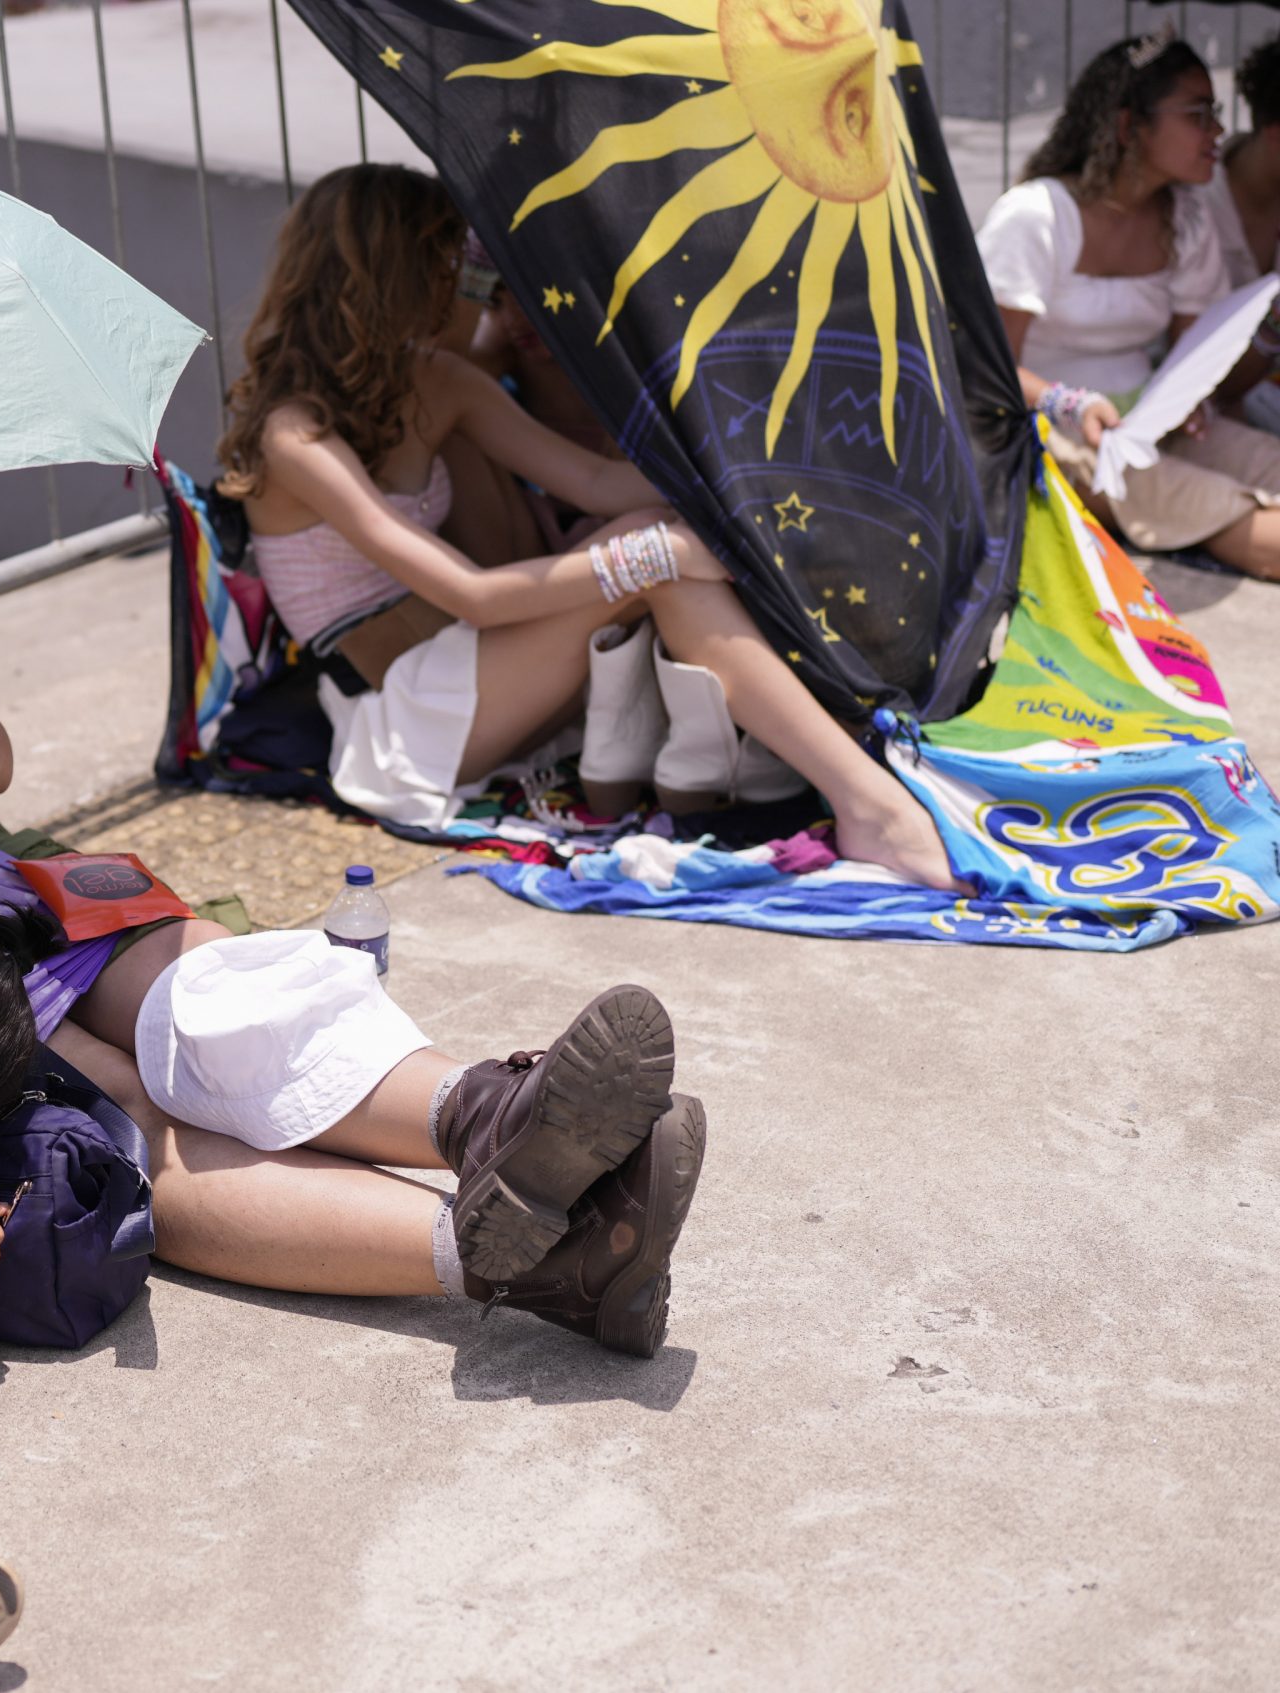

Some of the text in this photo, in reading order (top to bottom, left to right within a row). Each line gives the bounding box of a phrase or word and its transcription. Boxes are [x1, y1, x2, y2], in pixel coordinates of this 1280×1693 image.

[1017, 699, 1114, 733] TUCUNS
[63, 866, 136, 893] gel
[86, 881, 144, 894] termo
